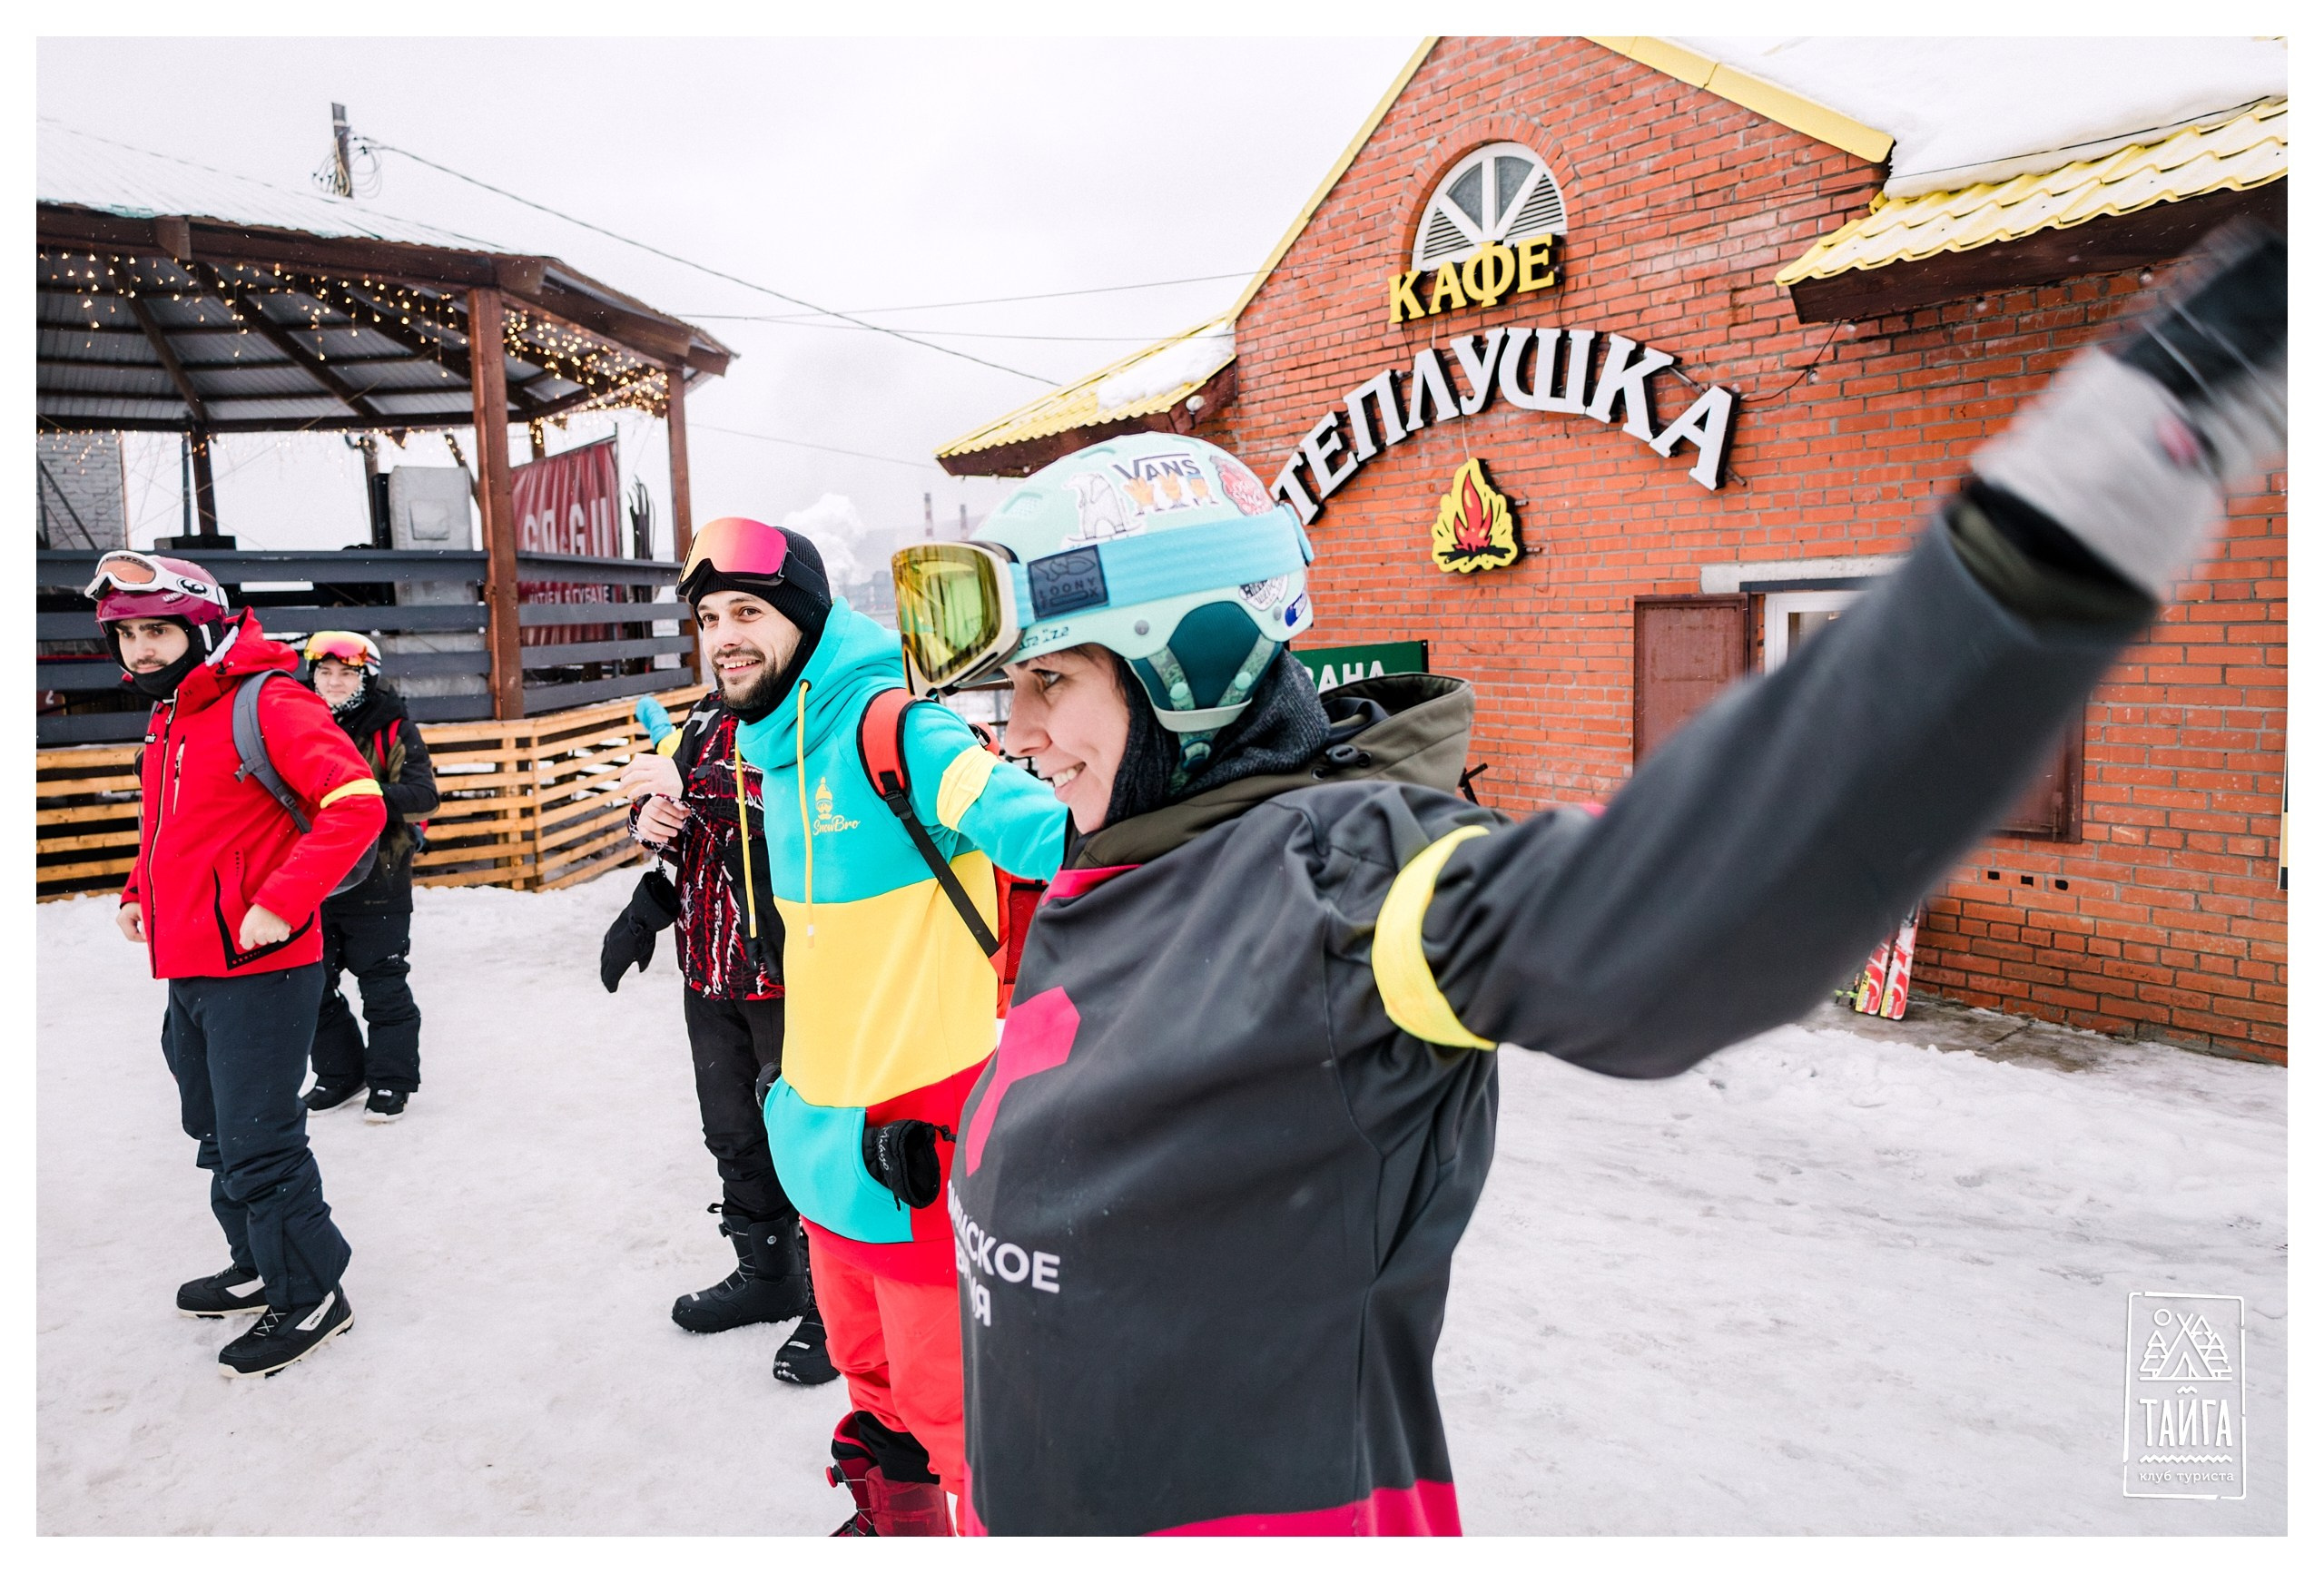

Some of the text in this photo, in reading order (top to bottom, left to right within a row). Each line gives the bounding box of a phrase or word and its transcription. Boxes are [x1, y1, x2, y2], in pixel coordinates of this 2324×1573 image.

[1388, 232, 1557, 324] КАФЕ
[1113, 453, 1201, 481] VANS
[1269, 327, 1738, 526] ТЕПЛУШКА
